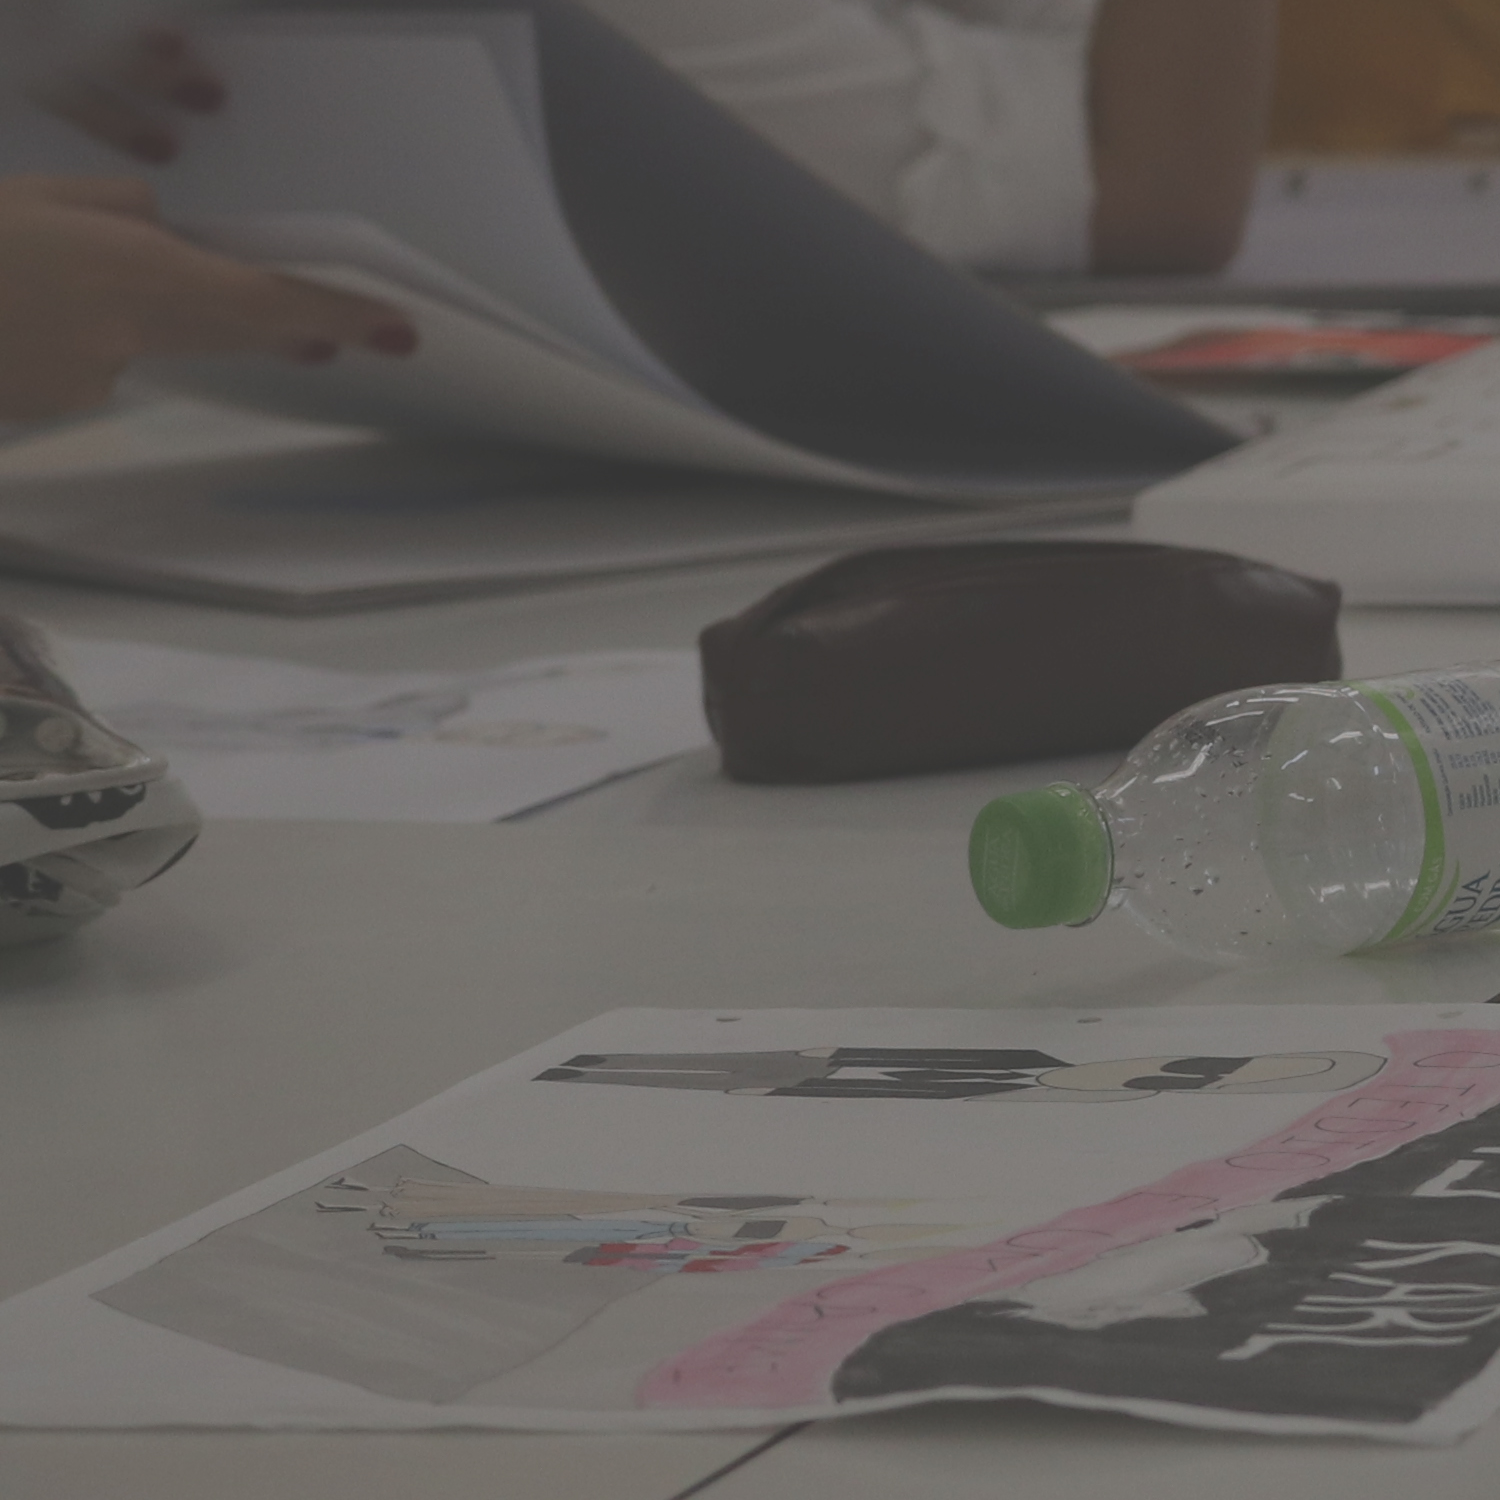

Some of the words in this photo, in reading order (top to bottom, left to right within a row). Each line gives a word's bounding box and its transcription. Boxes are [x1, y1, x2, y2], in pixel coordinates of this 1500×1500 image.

[1412, 884, 1436, 913] COM
[1224, 1081, 1479, 1171] TÉDIO
[976, 1229, 1110, 1274] UM
